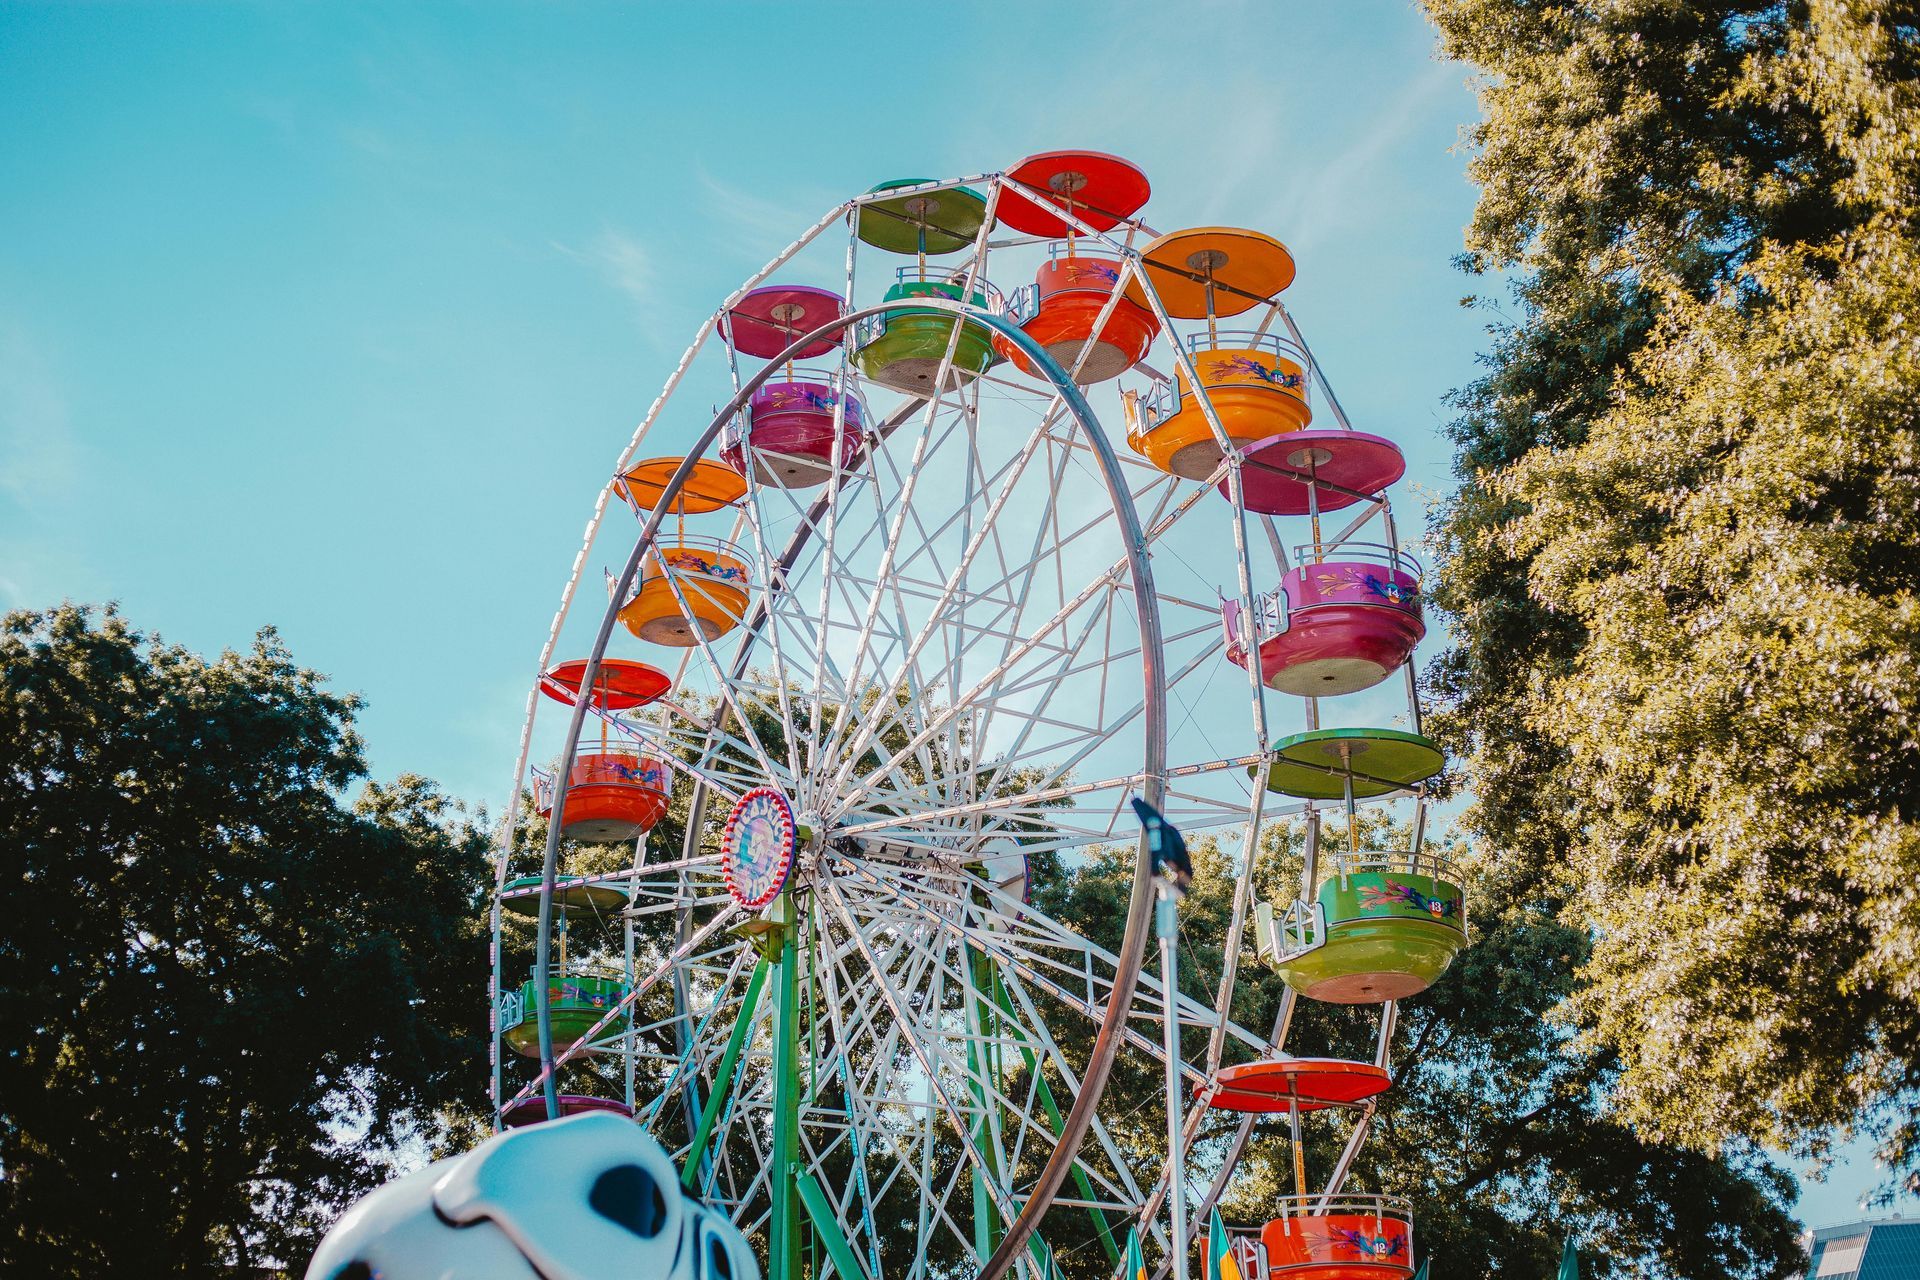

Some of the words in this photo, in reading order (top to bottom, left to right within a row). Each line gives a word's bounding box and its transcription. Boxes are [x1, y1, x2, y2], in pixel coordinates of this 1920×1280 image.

[1274, 374, 1284, 384] 15
[1388, 587, 1400, 598] 14
[1431, 901, 1442, 912] 13
[1375, 1242, 1386, 1254] 12
